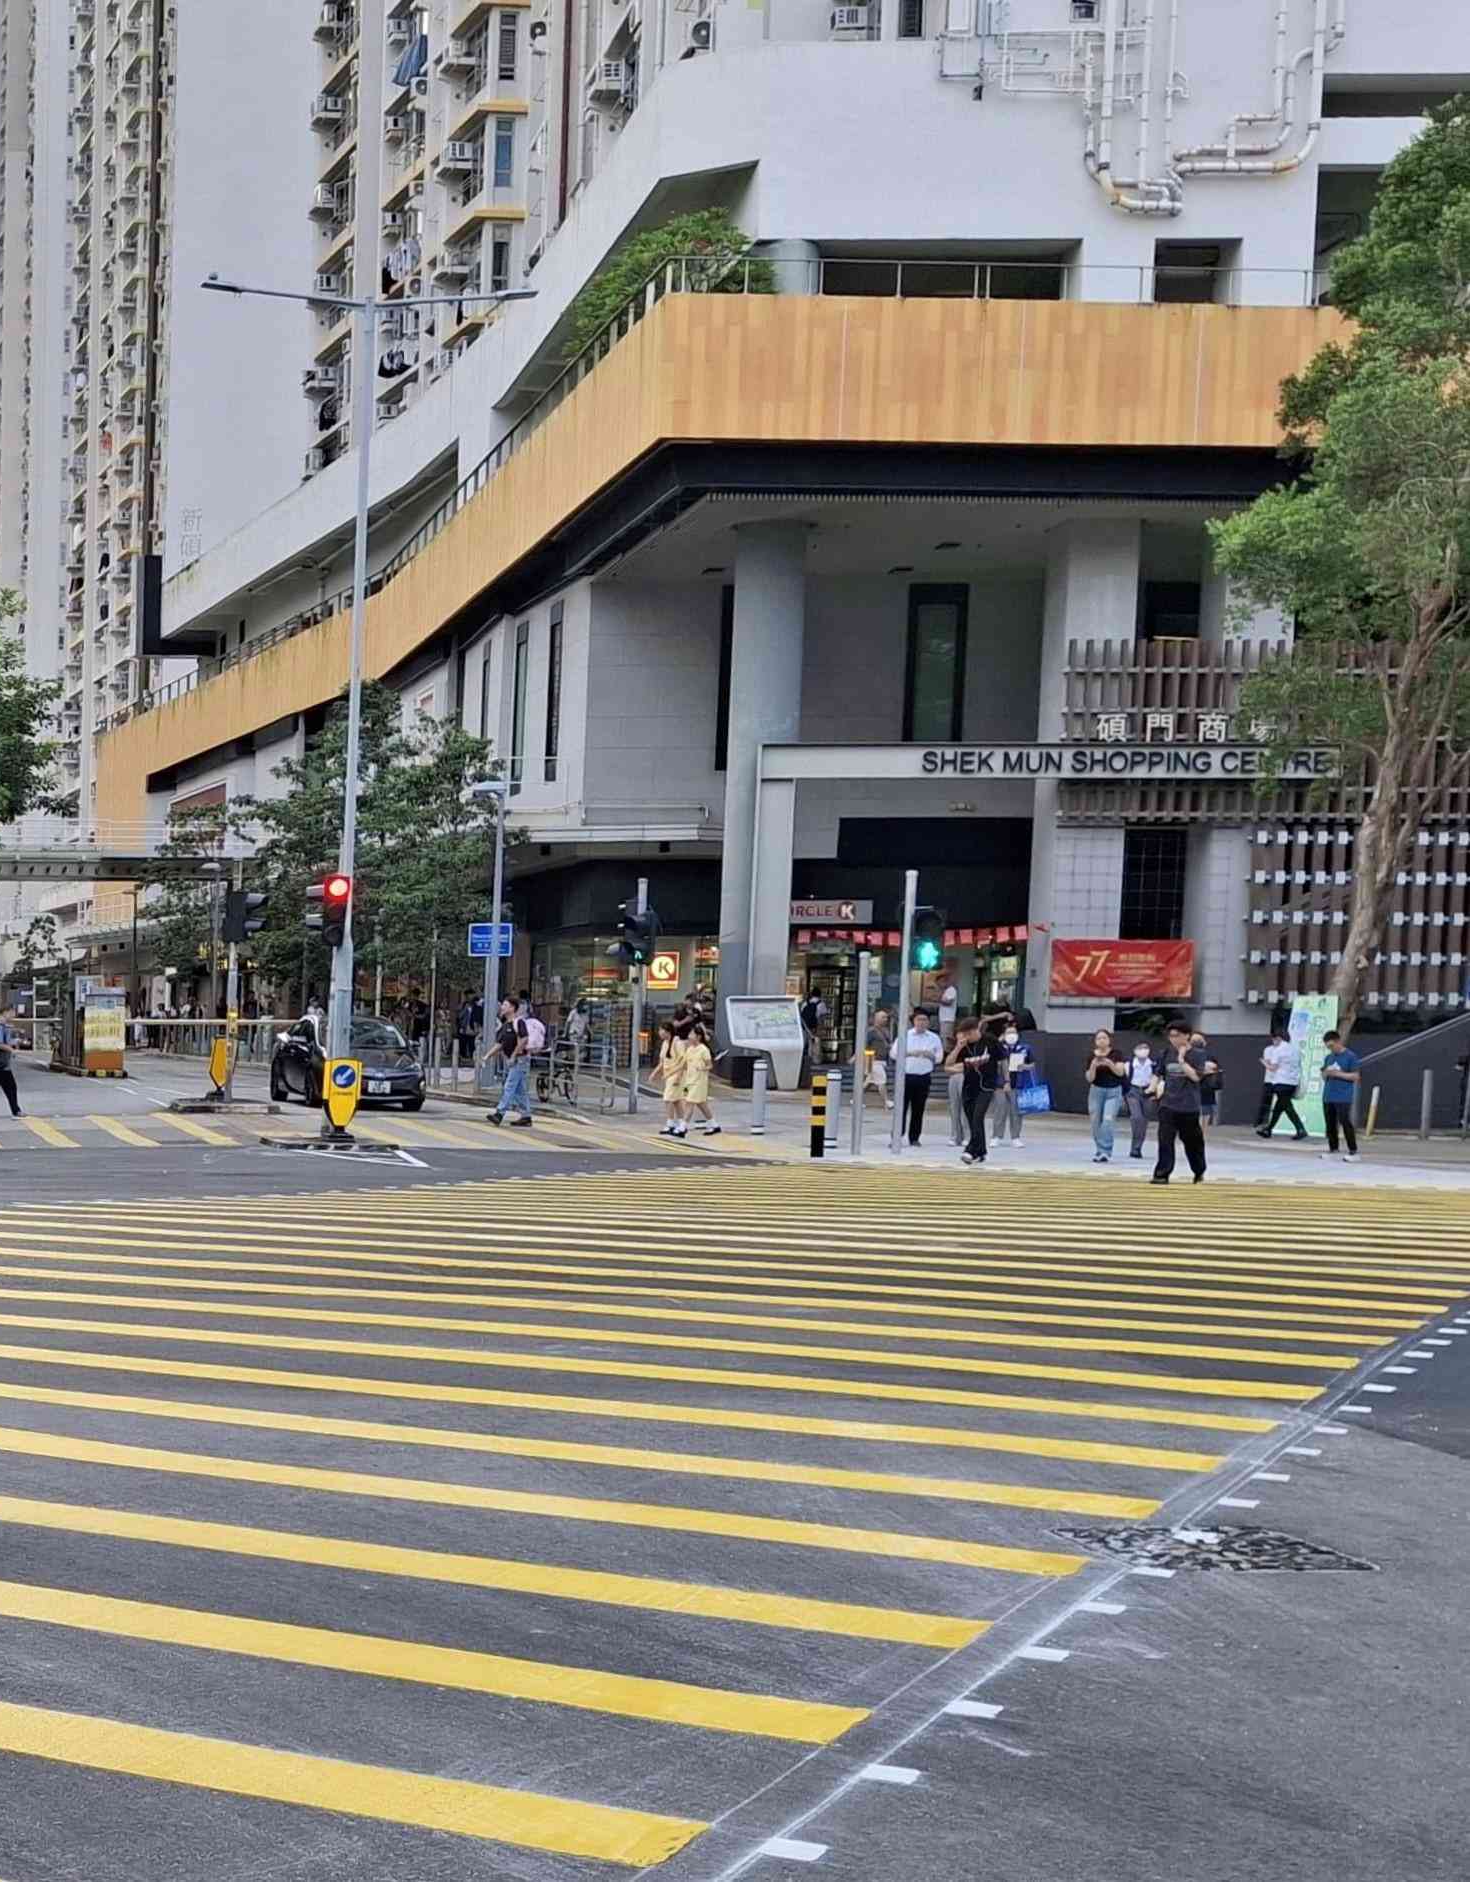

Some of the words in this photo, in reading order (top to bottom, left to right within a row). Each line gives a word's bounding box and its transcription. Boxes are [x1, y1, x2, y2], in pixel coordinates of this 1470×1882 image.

[921, 750, 994, 774] SHEK
[1002, 750, 1063, 774] MUN
[1070, 750, 1213, 774] SHOPPING
[840, 902, 855, 920] K
[1074, 950, 1110, 982] 77
